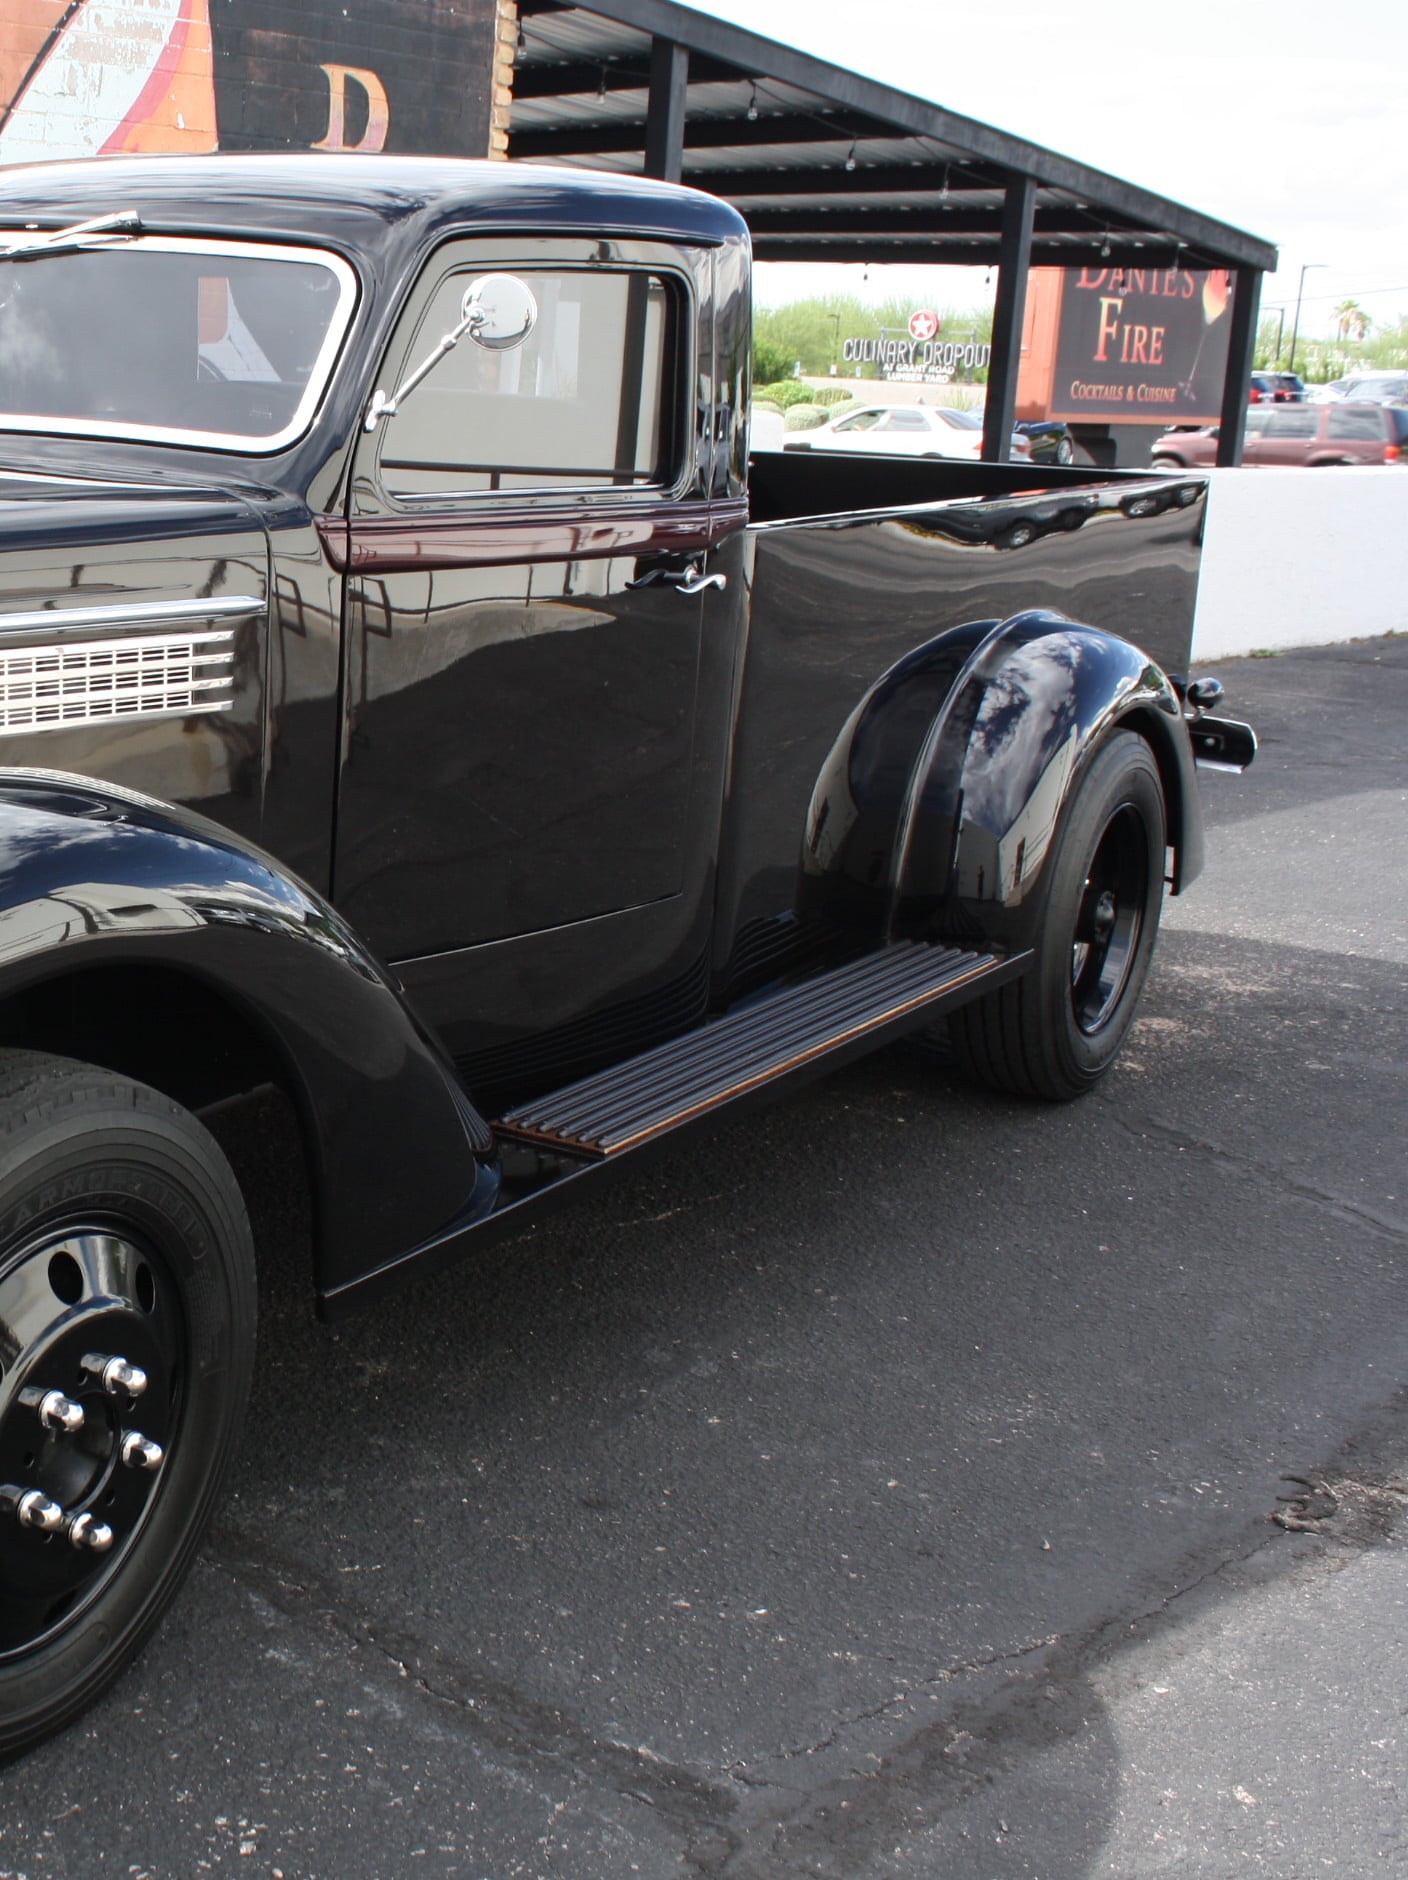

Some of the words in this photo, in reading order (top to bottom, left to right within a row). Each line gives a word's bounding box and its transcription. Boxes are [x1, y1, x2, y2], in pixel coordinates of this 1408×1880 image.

[310, 63, 390, 153] D
[1093, 297, 1165, 364] FIRE
[843, 339, 917, 363] CULINARY
[923, 342, 991, 367] DROPOUT
[882, 363, 895, 372] AT
[896, 363, 927, 373] GRANT
[928, 365, 955, 375] ROAD
[886, 372, 923, 382] LUMBER
[924, 374, 950, 384] YARD
[1070, 380, 1124, 401] COCKTAILS
[1126, 384, 1136, 401] &
[1137, 383, 1177, 402] CUISINE
